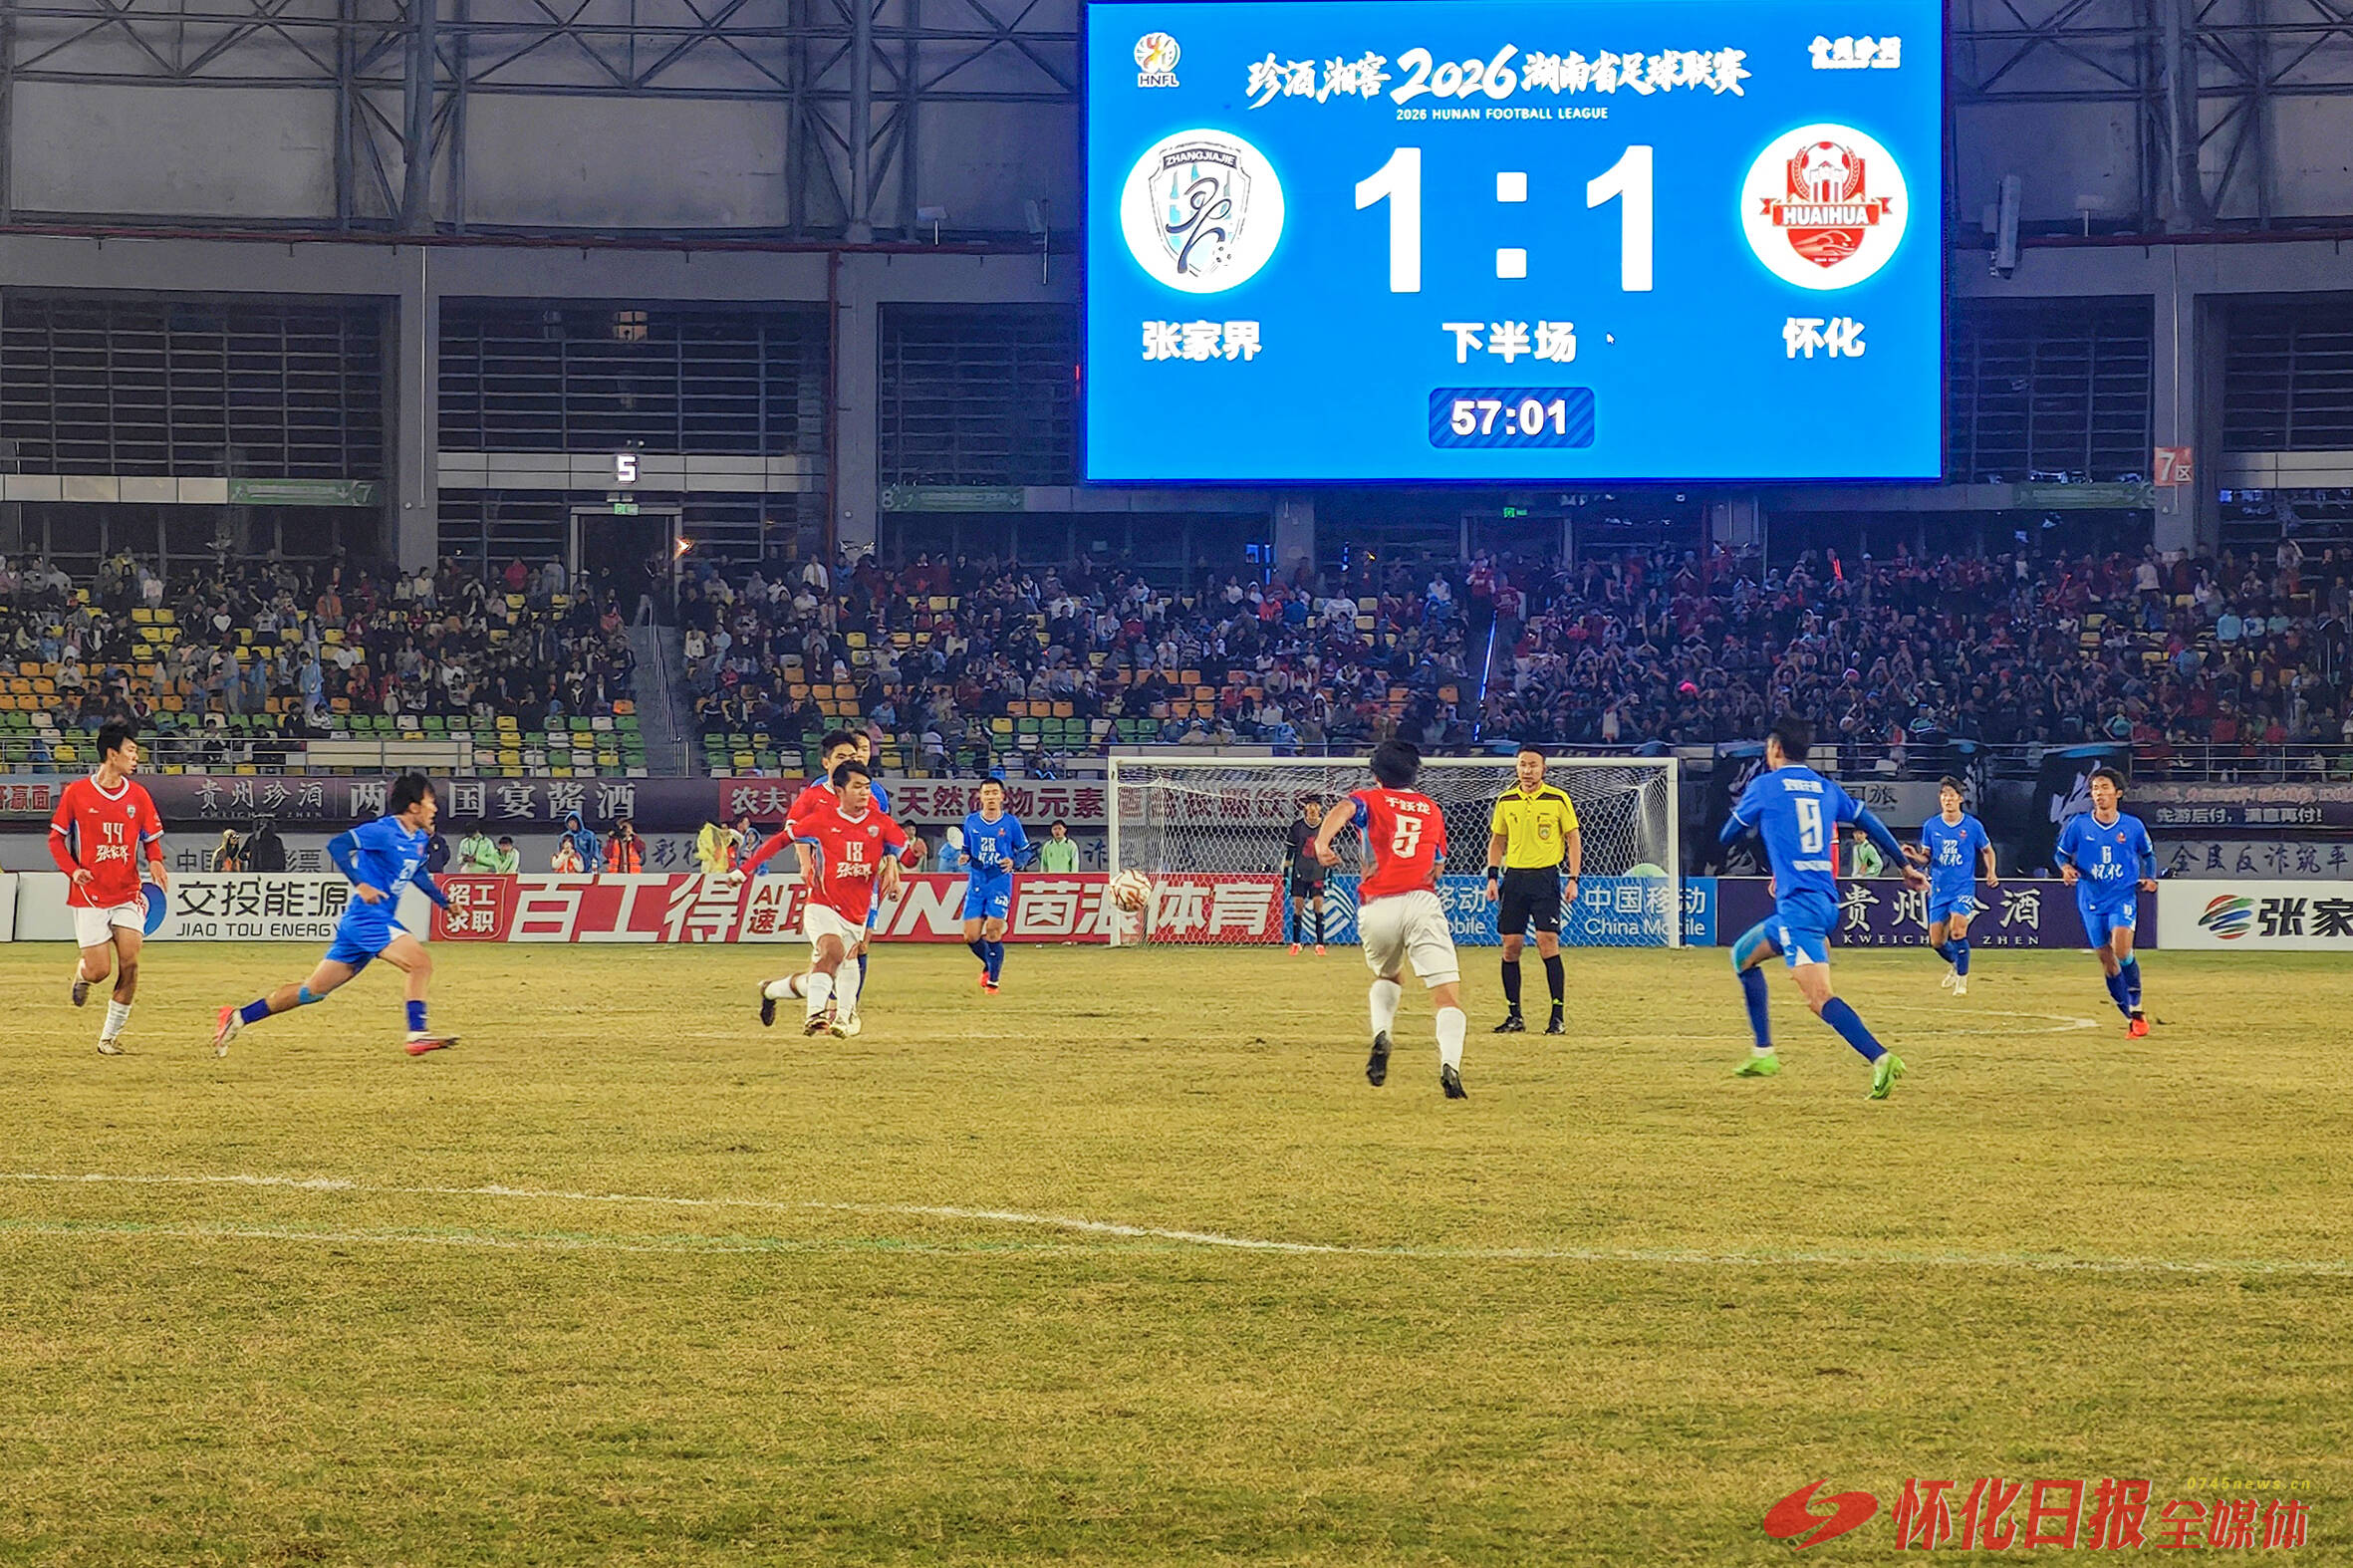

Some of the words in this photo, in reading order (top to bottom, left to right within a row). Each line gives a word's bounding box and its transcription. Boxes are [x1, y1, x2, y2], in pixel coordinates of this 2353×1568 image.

[1140, 75, 1177, 86] HNFL
[1397, 109, 1428, 121] 2026
[1433, 109, 1480, 121] HUNAN
[1485, 108, 1553, 121] FOOTBALL
[1558, 107, 1608, 120] LEAGUE
[1164, 150, 1236, 167] ZHANGJIAJIE
[1355, 146, 1422, 293] 1
[1587, 144, 1653, 292] 1
[1783, 205, 1869, 225] HUAIHUA
[1142, 320, 1262, 362] 张家界
[1442, 322, 1577, 364] 下半场
[1783, 317, 1867, 359] 怀化
[1450, 399, 1568, 436] 57:01
[618, 455, 637, 482] 5
[195, 779, 324, 810] 贵州珍酒
[350, 781, 636, 820] 两国宴酱酒
[103, 822, 124, 844] 44
[846, 841, 865, 862] 18
[980, 837, 996, 852] 28
[1943, 841, 1959, 854] 22
[2102, 846, 2112, 864] 6
[176, 882, 349, 916] 交投能源
[448, 884, 496, 906] 招工
[754, 885, 784, 905] AI
[1585, 886, 1706, 915] 中国移动
[508, 874, 745, 942] 百工得
[176, 923, 217, 936] JIAO
[226, 923, 262, 936] TOU
[446, 911, 494, 933] 求职
[1585, 917, 1640, 935] China
[1645, 918, 1705, 935] Moile
[1983, 935, 2039, 944] ZHEN
